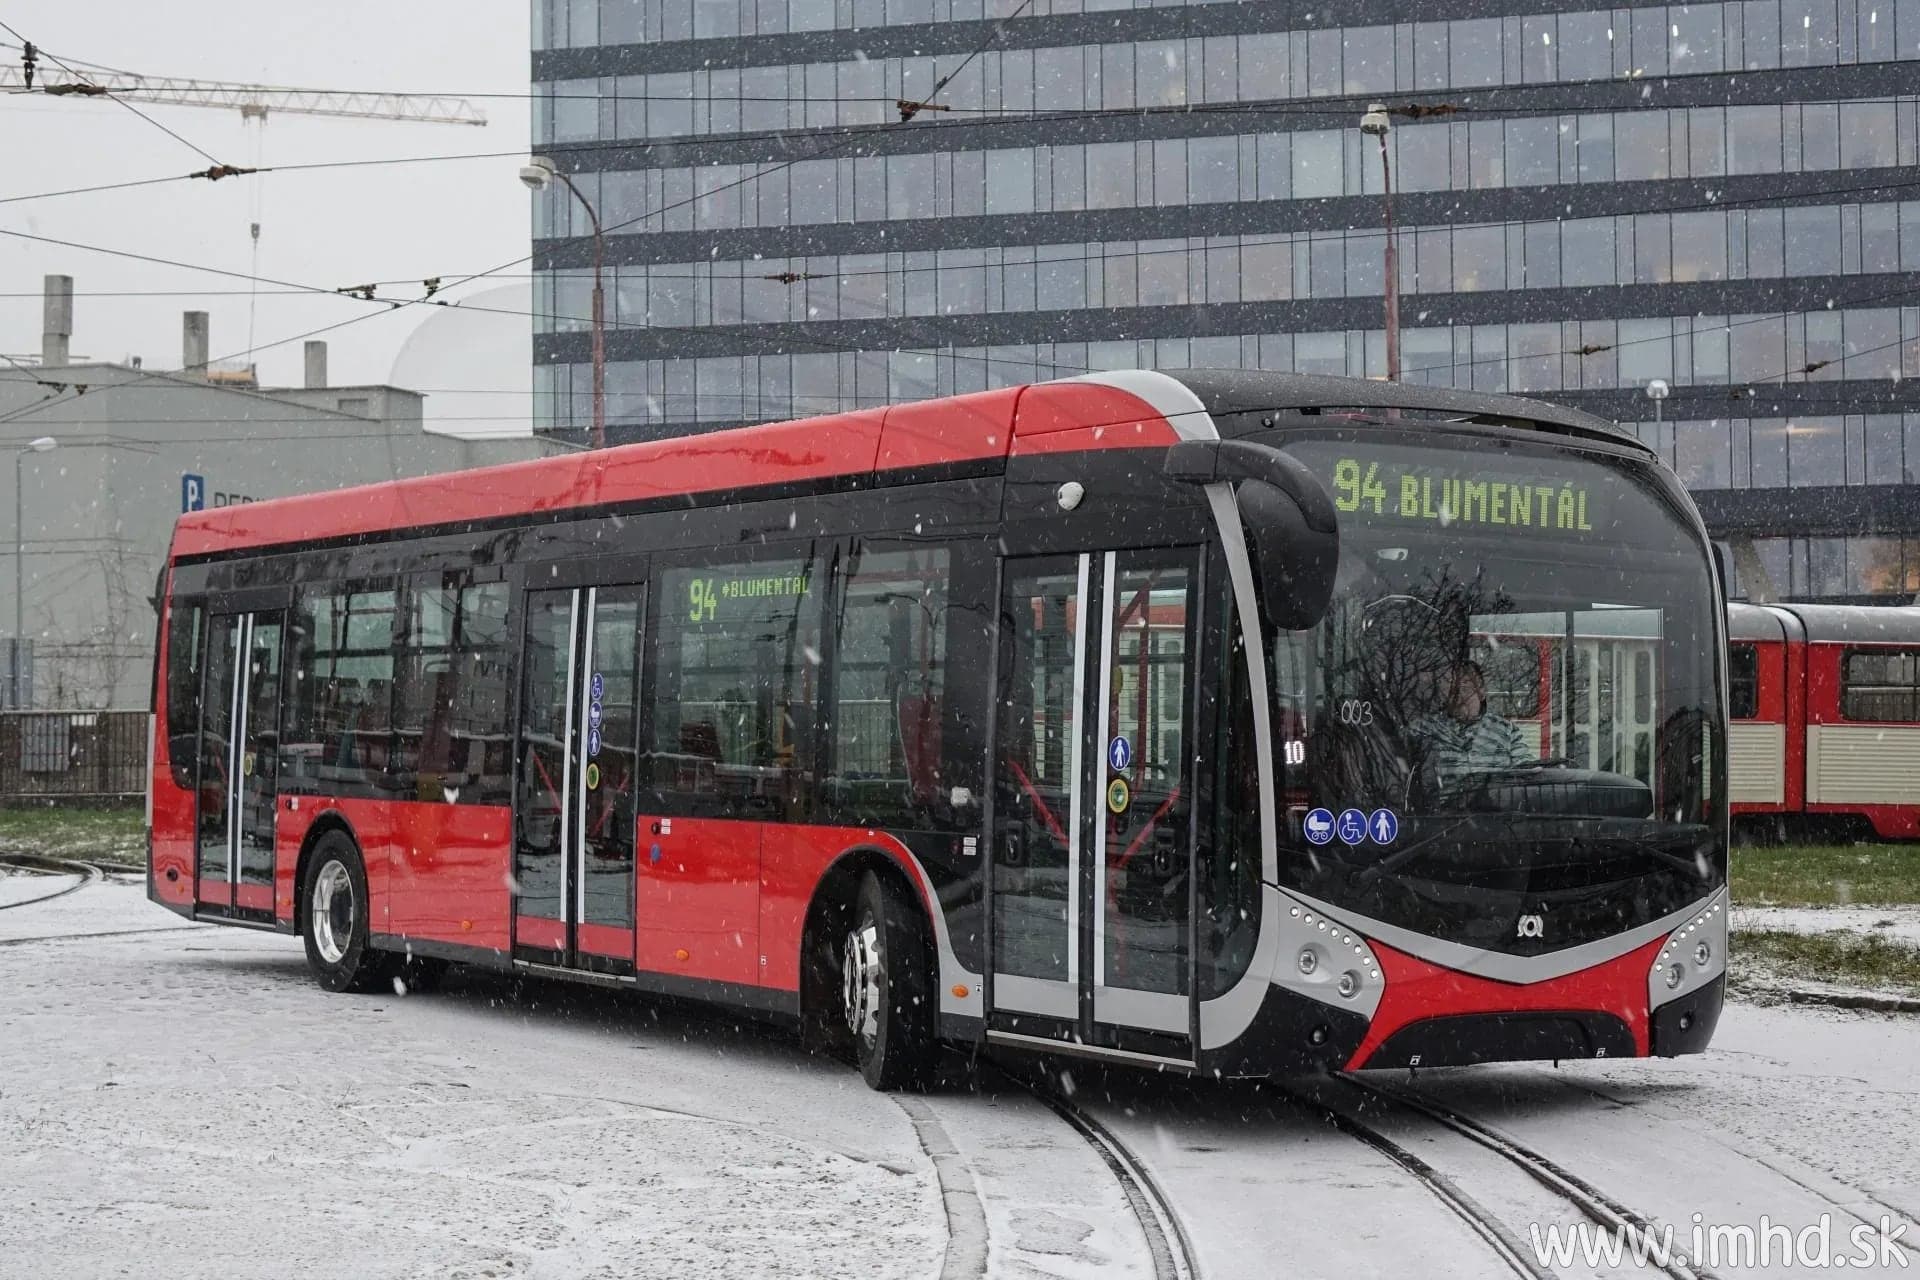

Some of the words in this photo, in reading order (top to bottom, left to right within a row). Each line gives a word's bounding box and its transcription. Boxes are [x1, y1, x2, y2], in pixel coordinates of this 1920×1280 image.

[187, 479, 198, 511] P
[1335, 459, 1386, 513] 94
[1400, 475, 1592, 530] BLUMENTÁL
[690, 579, 717, 620] 94
[1341, 700, 1373, 726] 003
[1284, 741, 1304, 764] 10
